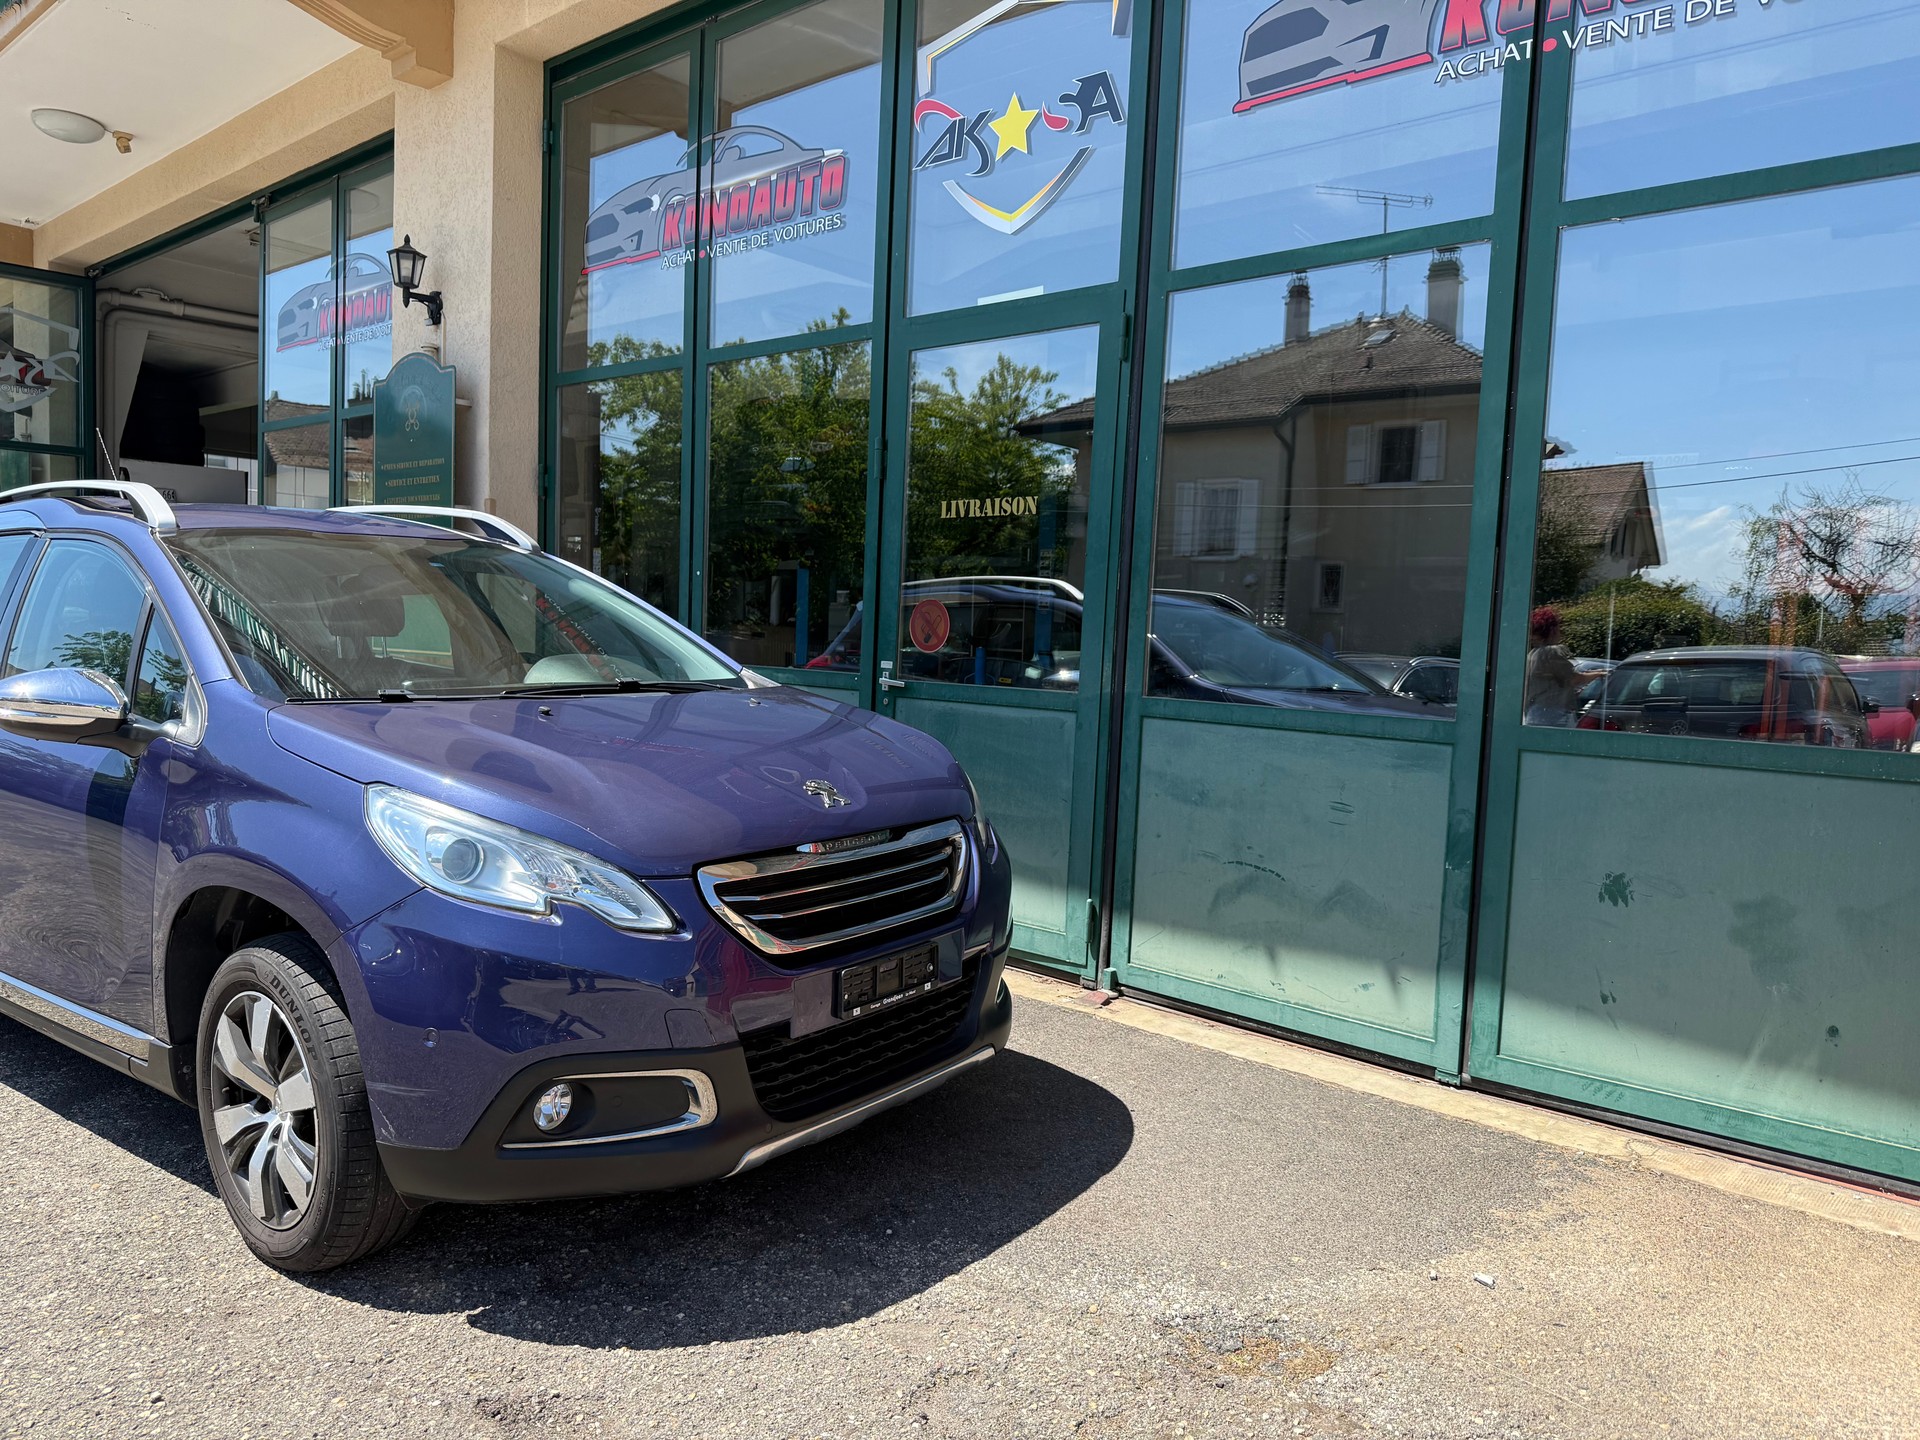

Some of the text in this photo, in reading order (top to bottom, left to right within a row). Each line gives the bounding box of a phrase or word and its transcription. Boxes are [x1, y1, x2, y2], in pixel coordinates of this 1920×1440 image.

[1434, 38, 1534, 85] ACHAT
[1562, 4, 1673, 50] VENTE
[1684, 0, 1735, 24] DE
[663, 156, 846, 251] KONOAUTO
[661, 213, 842, 270] ACHAT VENTE DE VOITURES
[319, 284, 392, 339] KONOAU
[940, 496, 1039, 519] LIVRAISON
[269, 974, 318, 1061] DUNLOP
